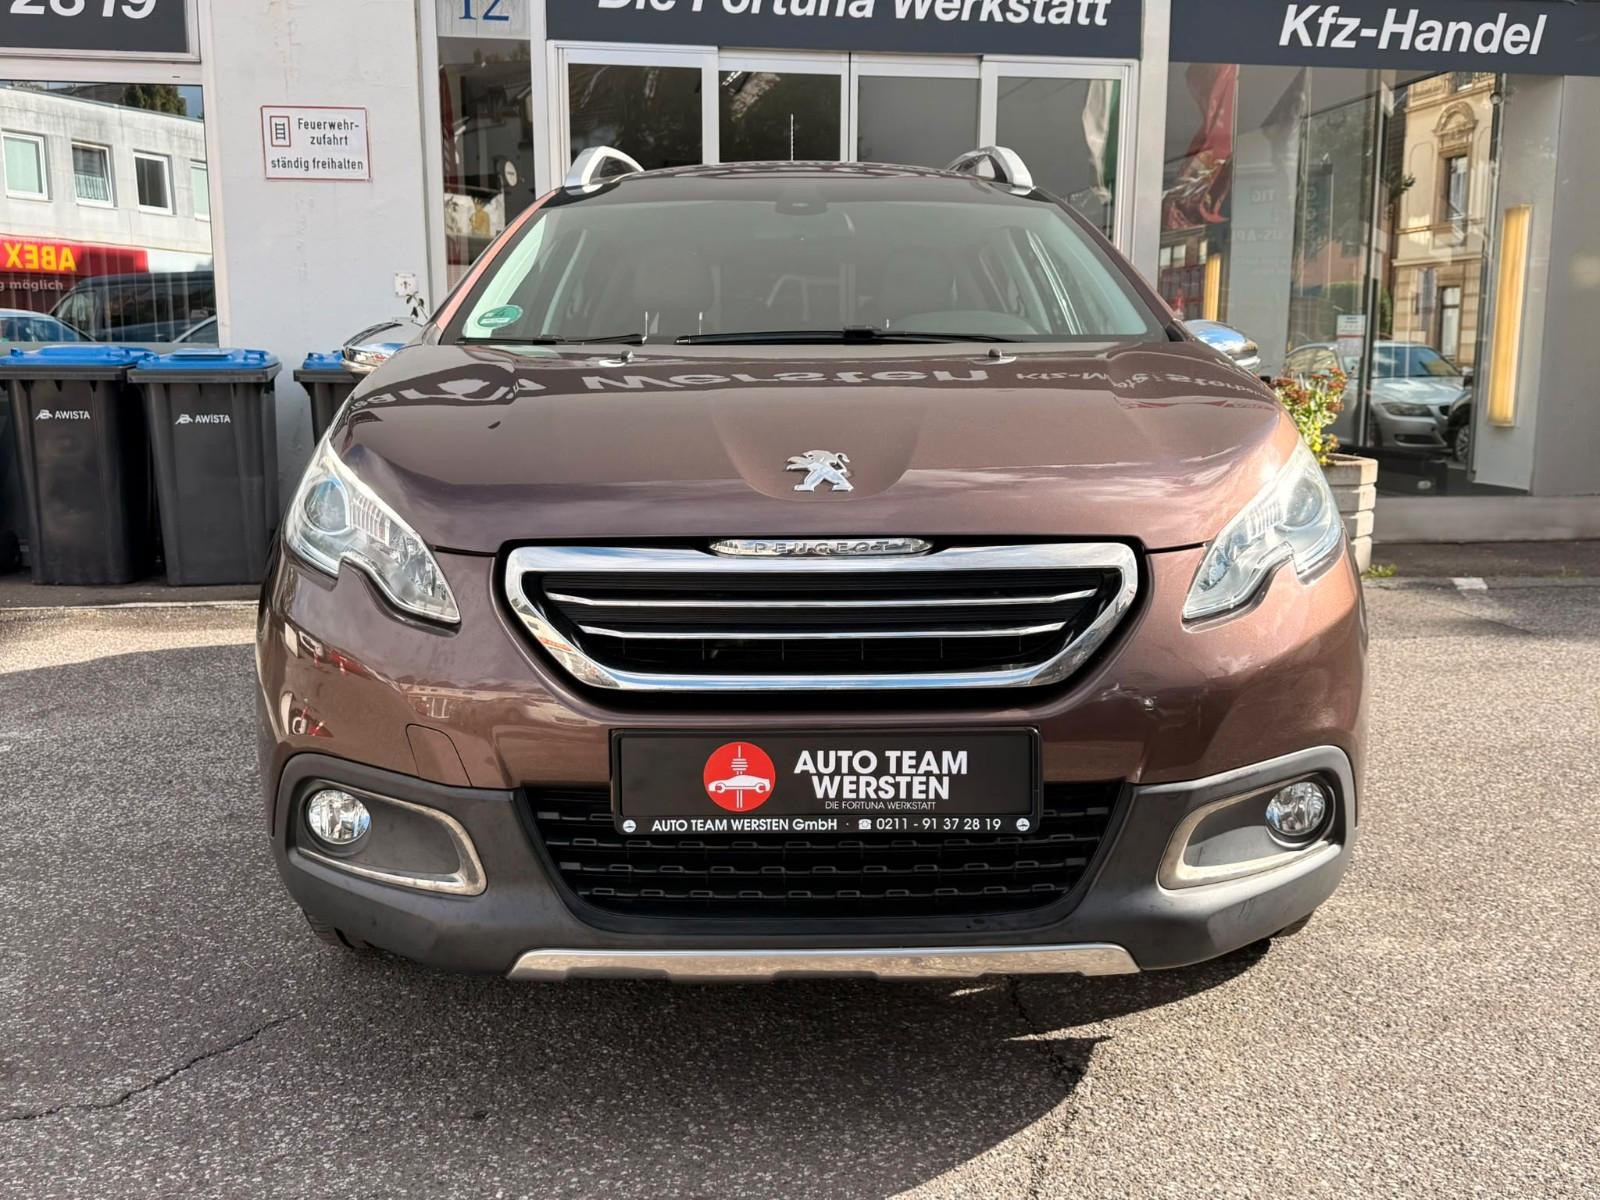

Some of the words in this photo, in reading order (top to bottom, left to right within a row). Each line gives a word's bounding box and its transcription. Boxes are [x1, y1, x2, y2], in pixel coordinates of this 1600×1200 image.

[1278, 4, 1548, 55] Kfz-Handel
[298, 118, 360, 131] Feuerwehr-
[310, 133, 349, 146] zufahrt
[271, 156, 310, 172] ständig
[312, 158, 364, 170] freihalten
[9, 279, 64, 293] möglich
[54, 410, 91, 420] AWISTA
[195, 414, 231, 424] AWISTA
[793, 750, 878, 775] AUTO
[885, 750, 968, 775] TEAM
[811, 775, 950, 800] WERSTEN
[825, 801, 839, 810] DIE
[842, 801, 885, 810] FORTUNA
[887, 801, 937, 811] WERKSTATT
[651, 819, 688, 832] AUTO
[691, 818, 728, 831] TEAM
[731, 818, 789, 831] WERSTEN
[792, 818, 838, 831] GmbH
[876, 817, 908, 830] 0211
[922, 817, 937, 830] 91
[943, 817, 960, 830] 37
[963, 817, 981, 831] 28
[985, 818, 1001, 831] 19
